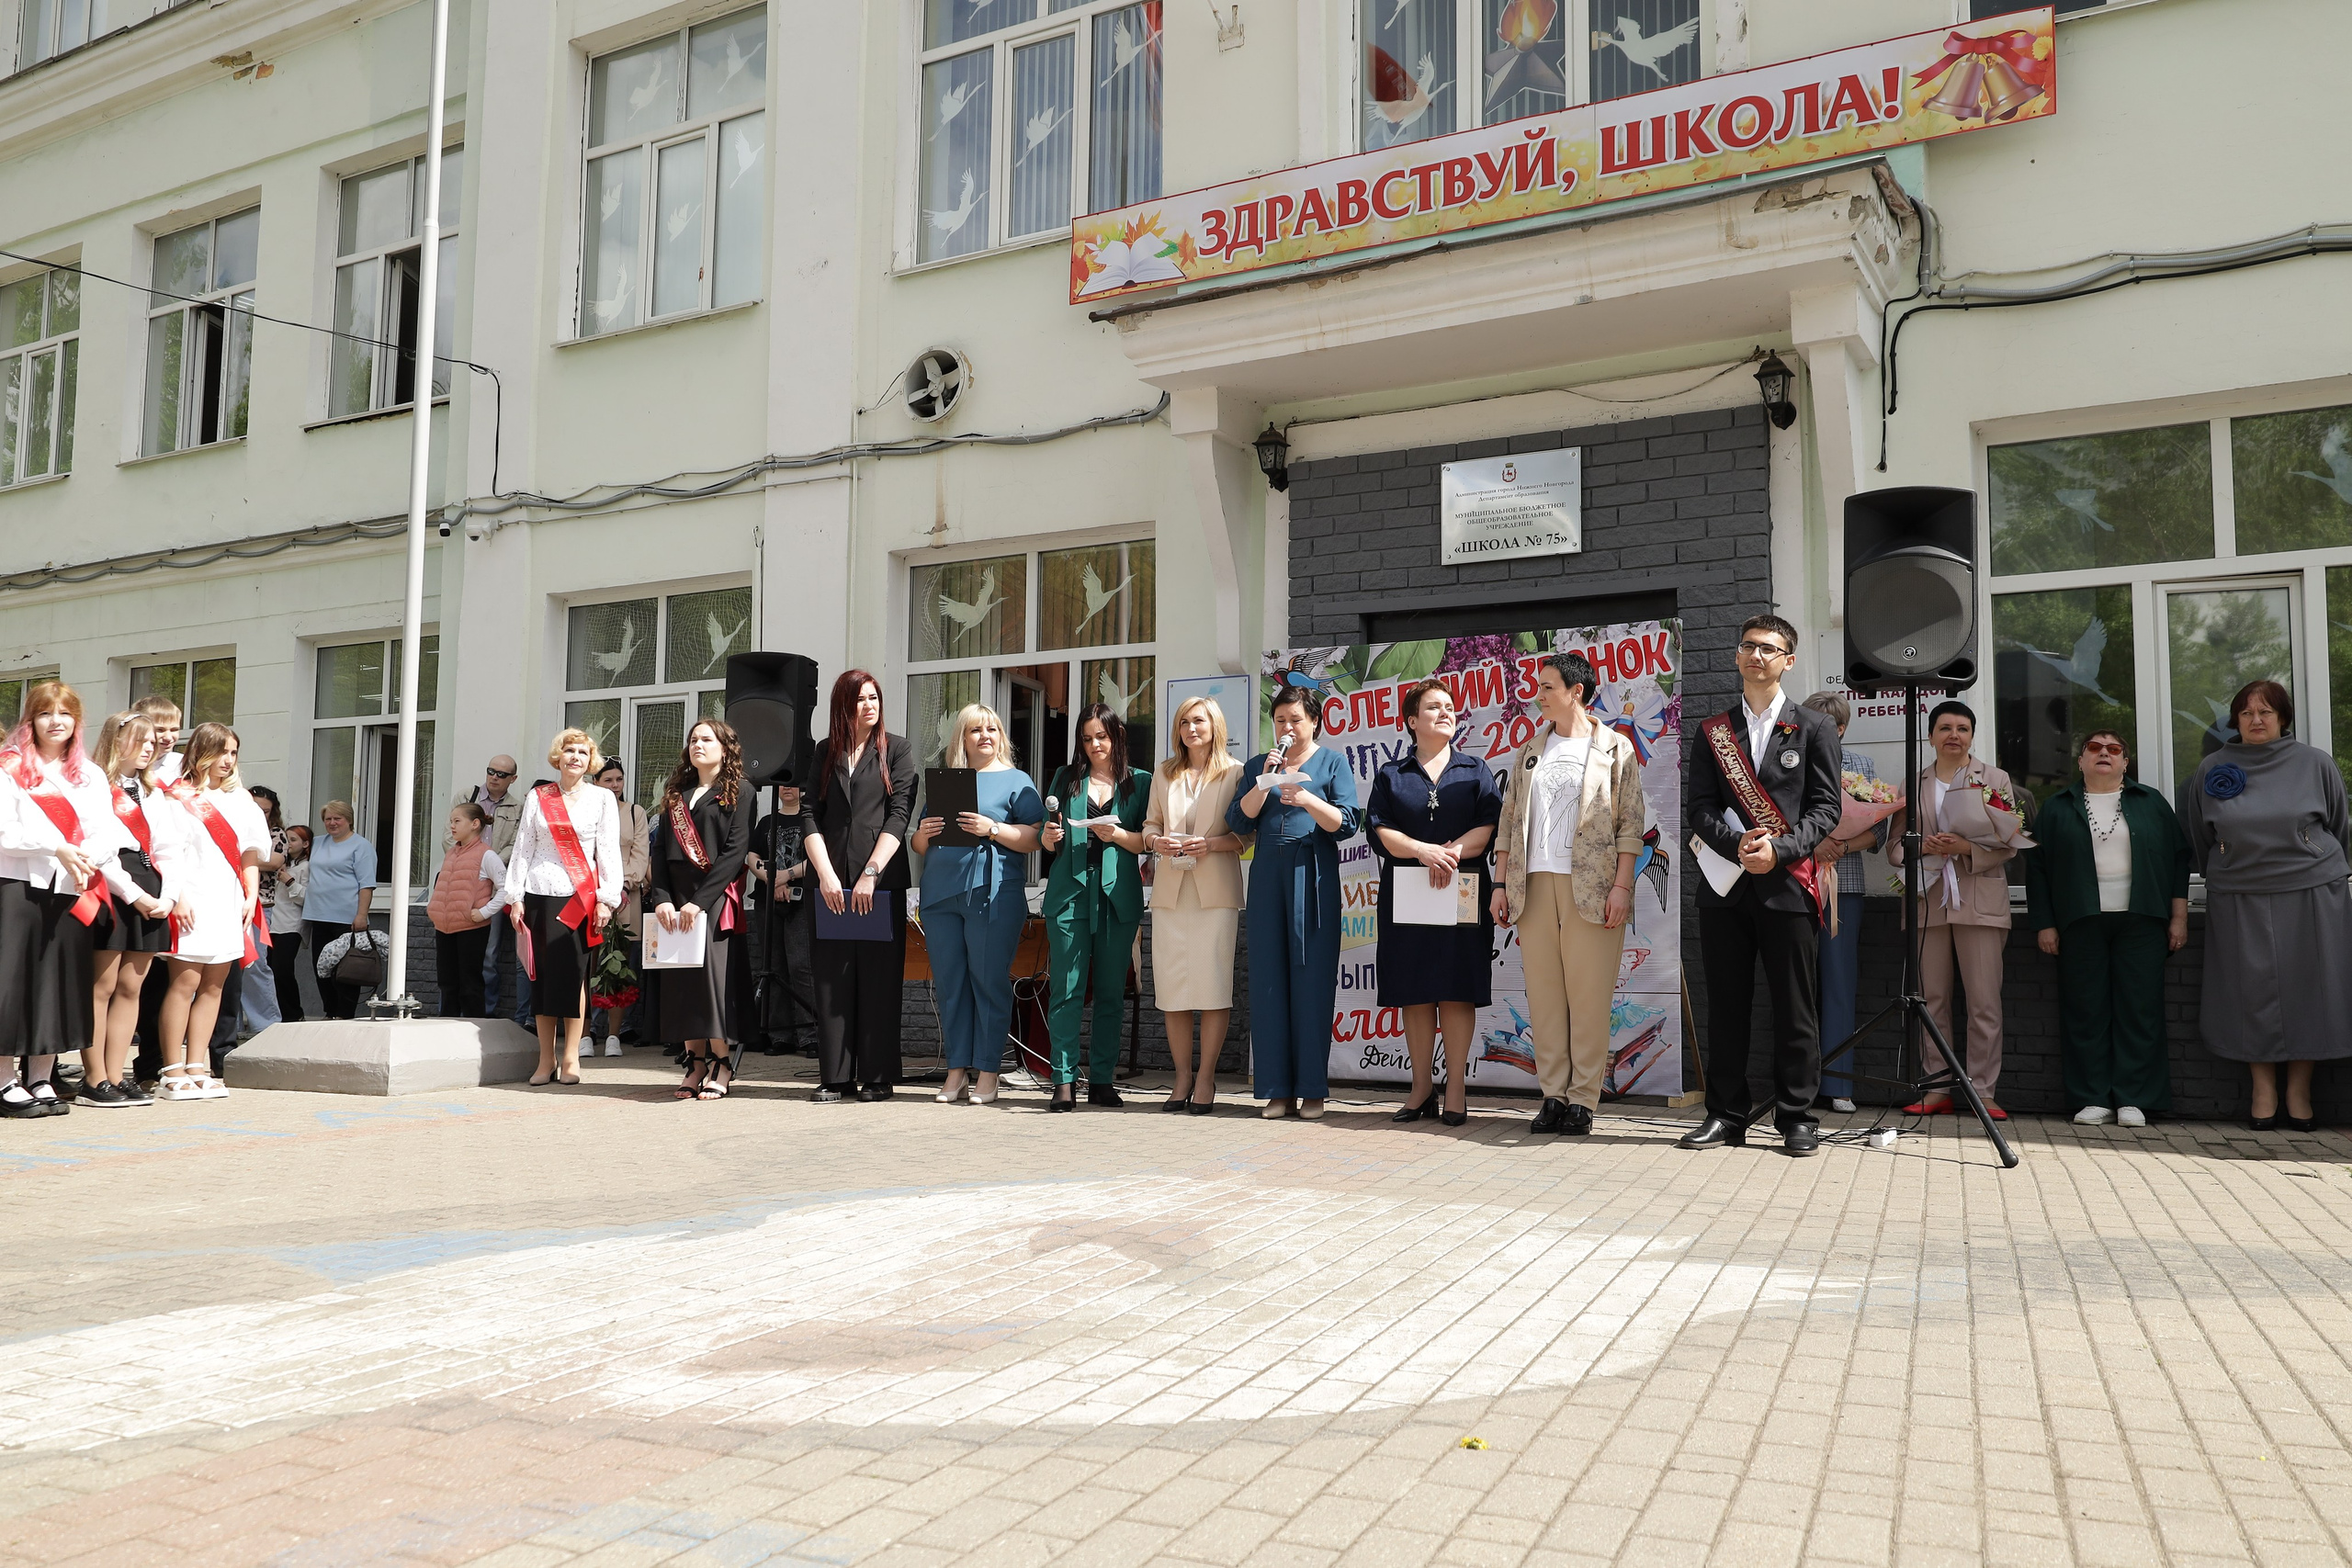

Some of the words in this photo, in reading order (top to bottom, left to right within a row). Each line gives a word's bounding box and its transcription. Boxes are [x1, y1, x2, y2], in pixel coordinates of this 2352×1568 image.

[1198, 126, 1577, 261] ЗДРАВСТВУЙ,
[1600, 65, 1901, 175] ШКОЛА!
[1497, 486, 1516, 494] города
[1544, 480, 1574, 489] Новгорода
[1478, 493, 1514, 502] Департамент
[1514, 490, 1549, 499] образования
[1454, 506, 1518, 519] МУНИЦИПАЛЬНОЕ
[1519, 502, 1566, 512] БЮДЖЕТНОЕ
[1466, 511, 1554, 525] ОБЩЕОБРАЗОВАТЕЛЬНОЕ
[1486, 520, 1533, 531] УЧРЕЖДЕНИЕ
[1453, 536, 1521, 553] «ШКОЛА
[1524, 535, 1543, 547] №
[1545, 532, 1567, 546] 75»
[1858, 704, 1928, 717] РЕБЕНА
[1341, 916, 1374, 938] АМ!
